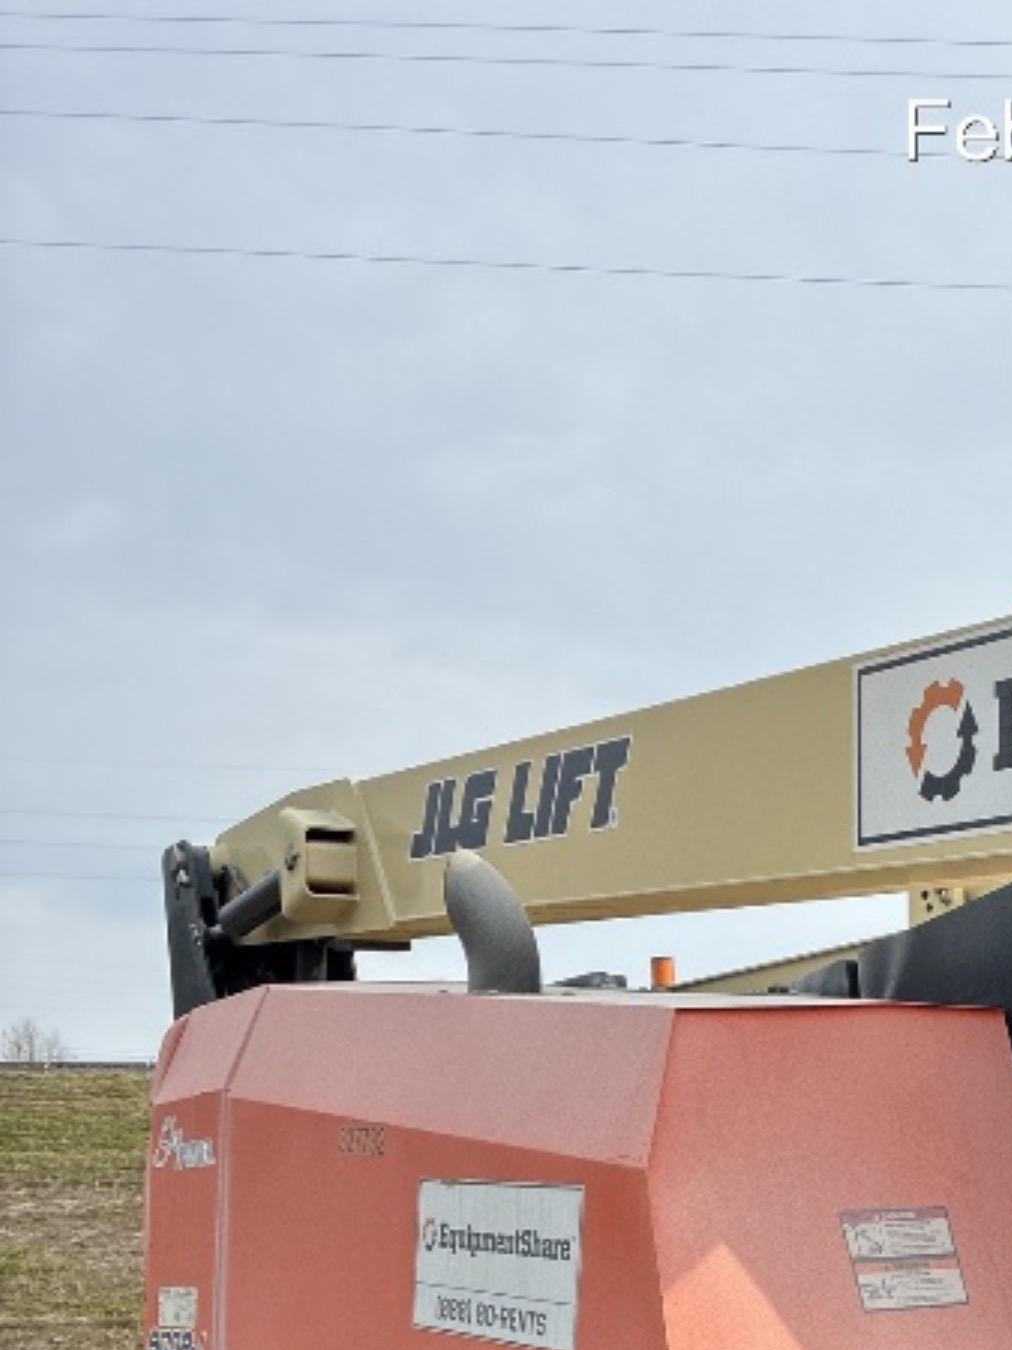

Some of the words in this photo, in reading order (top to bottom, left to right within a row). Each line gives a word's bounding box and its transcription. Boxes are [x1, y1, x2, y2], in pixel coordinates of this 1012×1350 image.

[409, 768, 499, 861] JLG
[503, 735, 633, 846] LIFT
[439, 1222, 572, 1261] EquipmentShare
